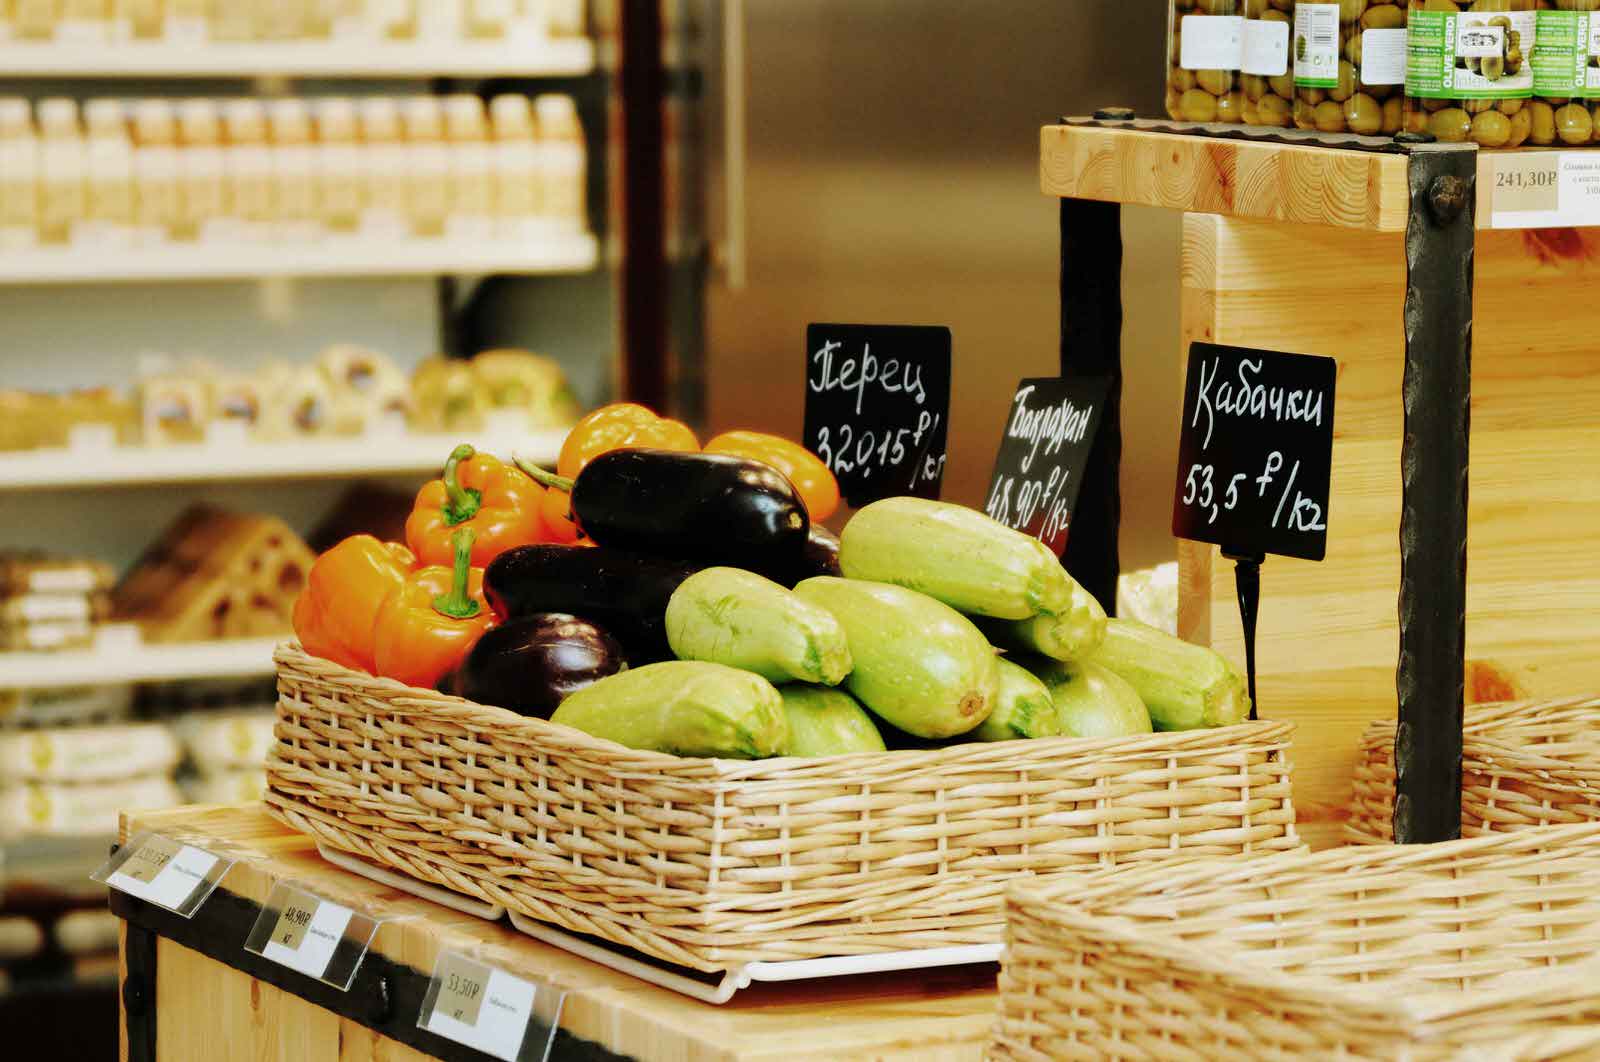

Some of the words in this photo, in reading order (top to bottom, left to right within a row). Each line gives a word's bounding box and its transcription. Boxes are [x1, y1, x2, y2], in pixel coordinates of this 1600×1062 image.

[1443, 54, 1453, 88] OLIVE
[1574, 53, 1585, 87] OLIVE
[809, 339, 926, 415] Перец
[1191, 356, 1323, 450] Кабачки
[1008, 385, 1093, 473] Баклажан
